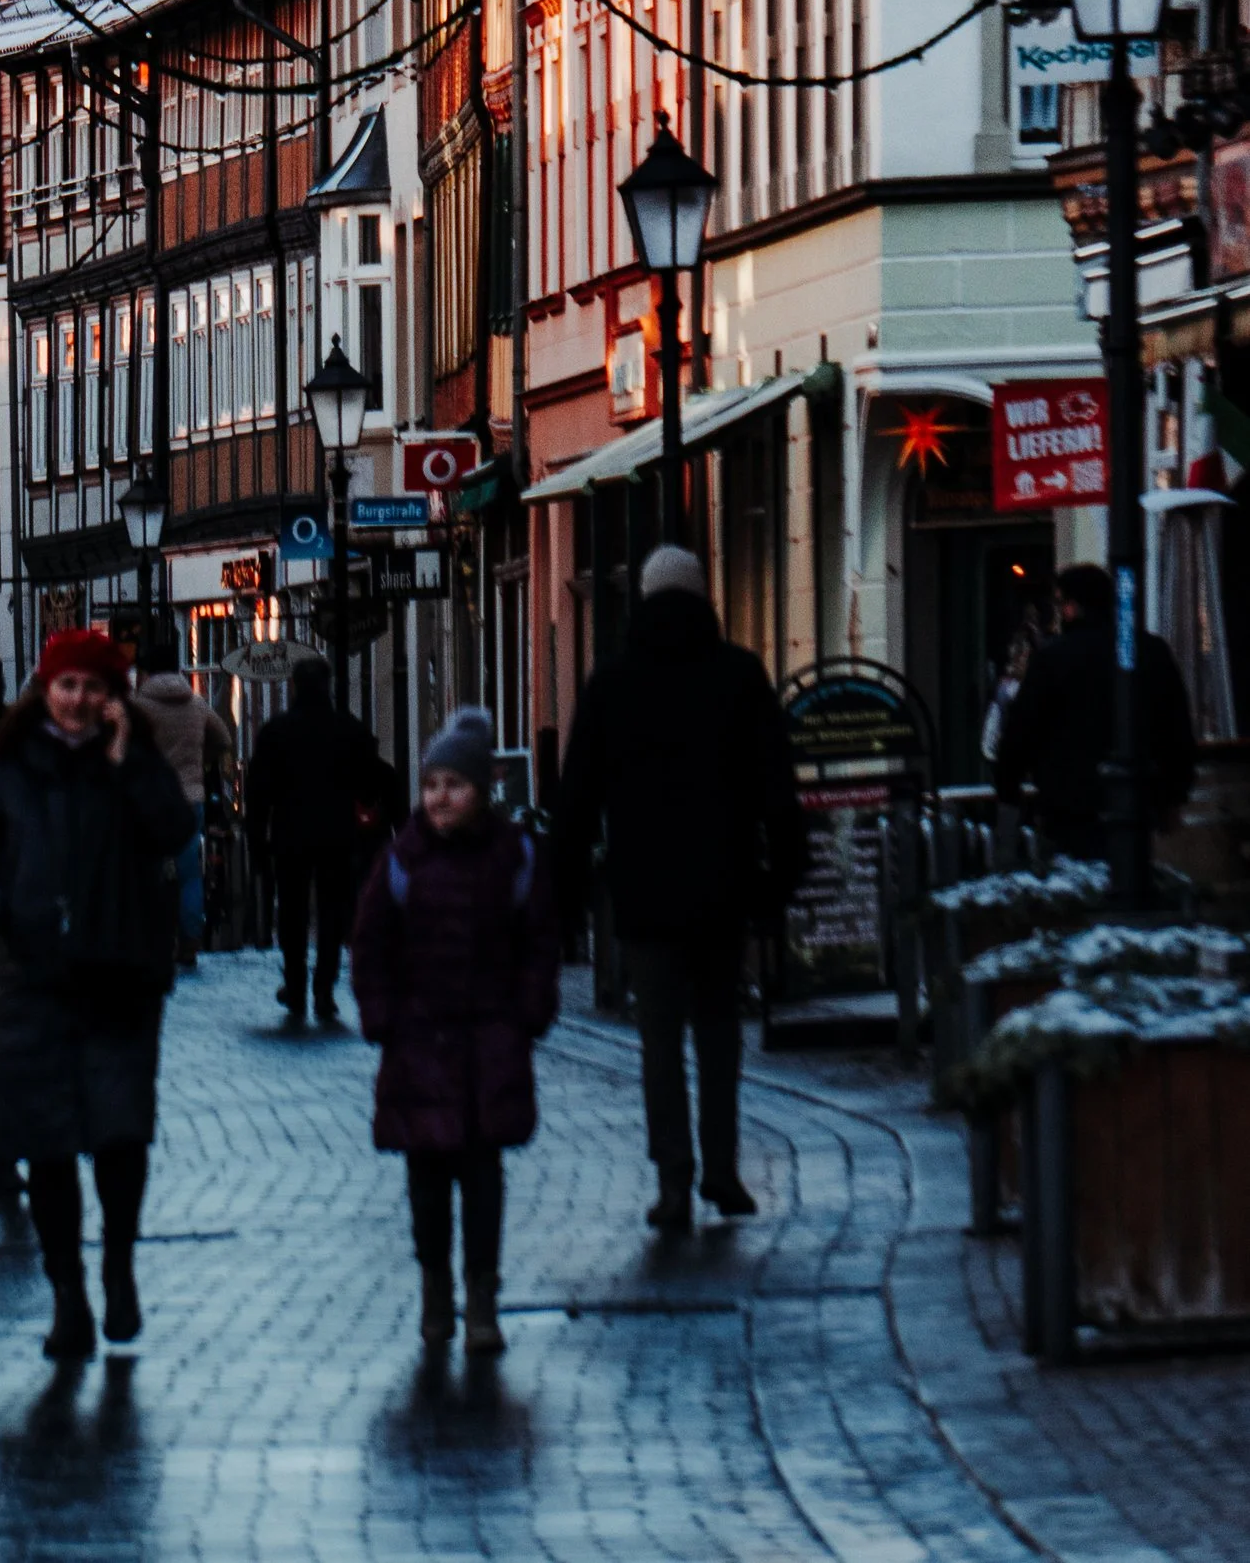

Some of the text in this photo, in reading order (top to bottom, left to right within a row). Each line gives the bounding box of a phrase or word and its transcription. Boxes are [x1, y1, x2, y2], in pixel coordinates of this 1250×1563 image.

[1017, 40, 1155, 71] Kochlöel
[1004, 397, 1051, 429] WIR
[1006, 422, 1104, 462] LIEFERN!
[357, 502, 423, 523] Burgstraße
